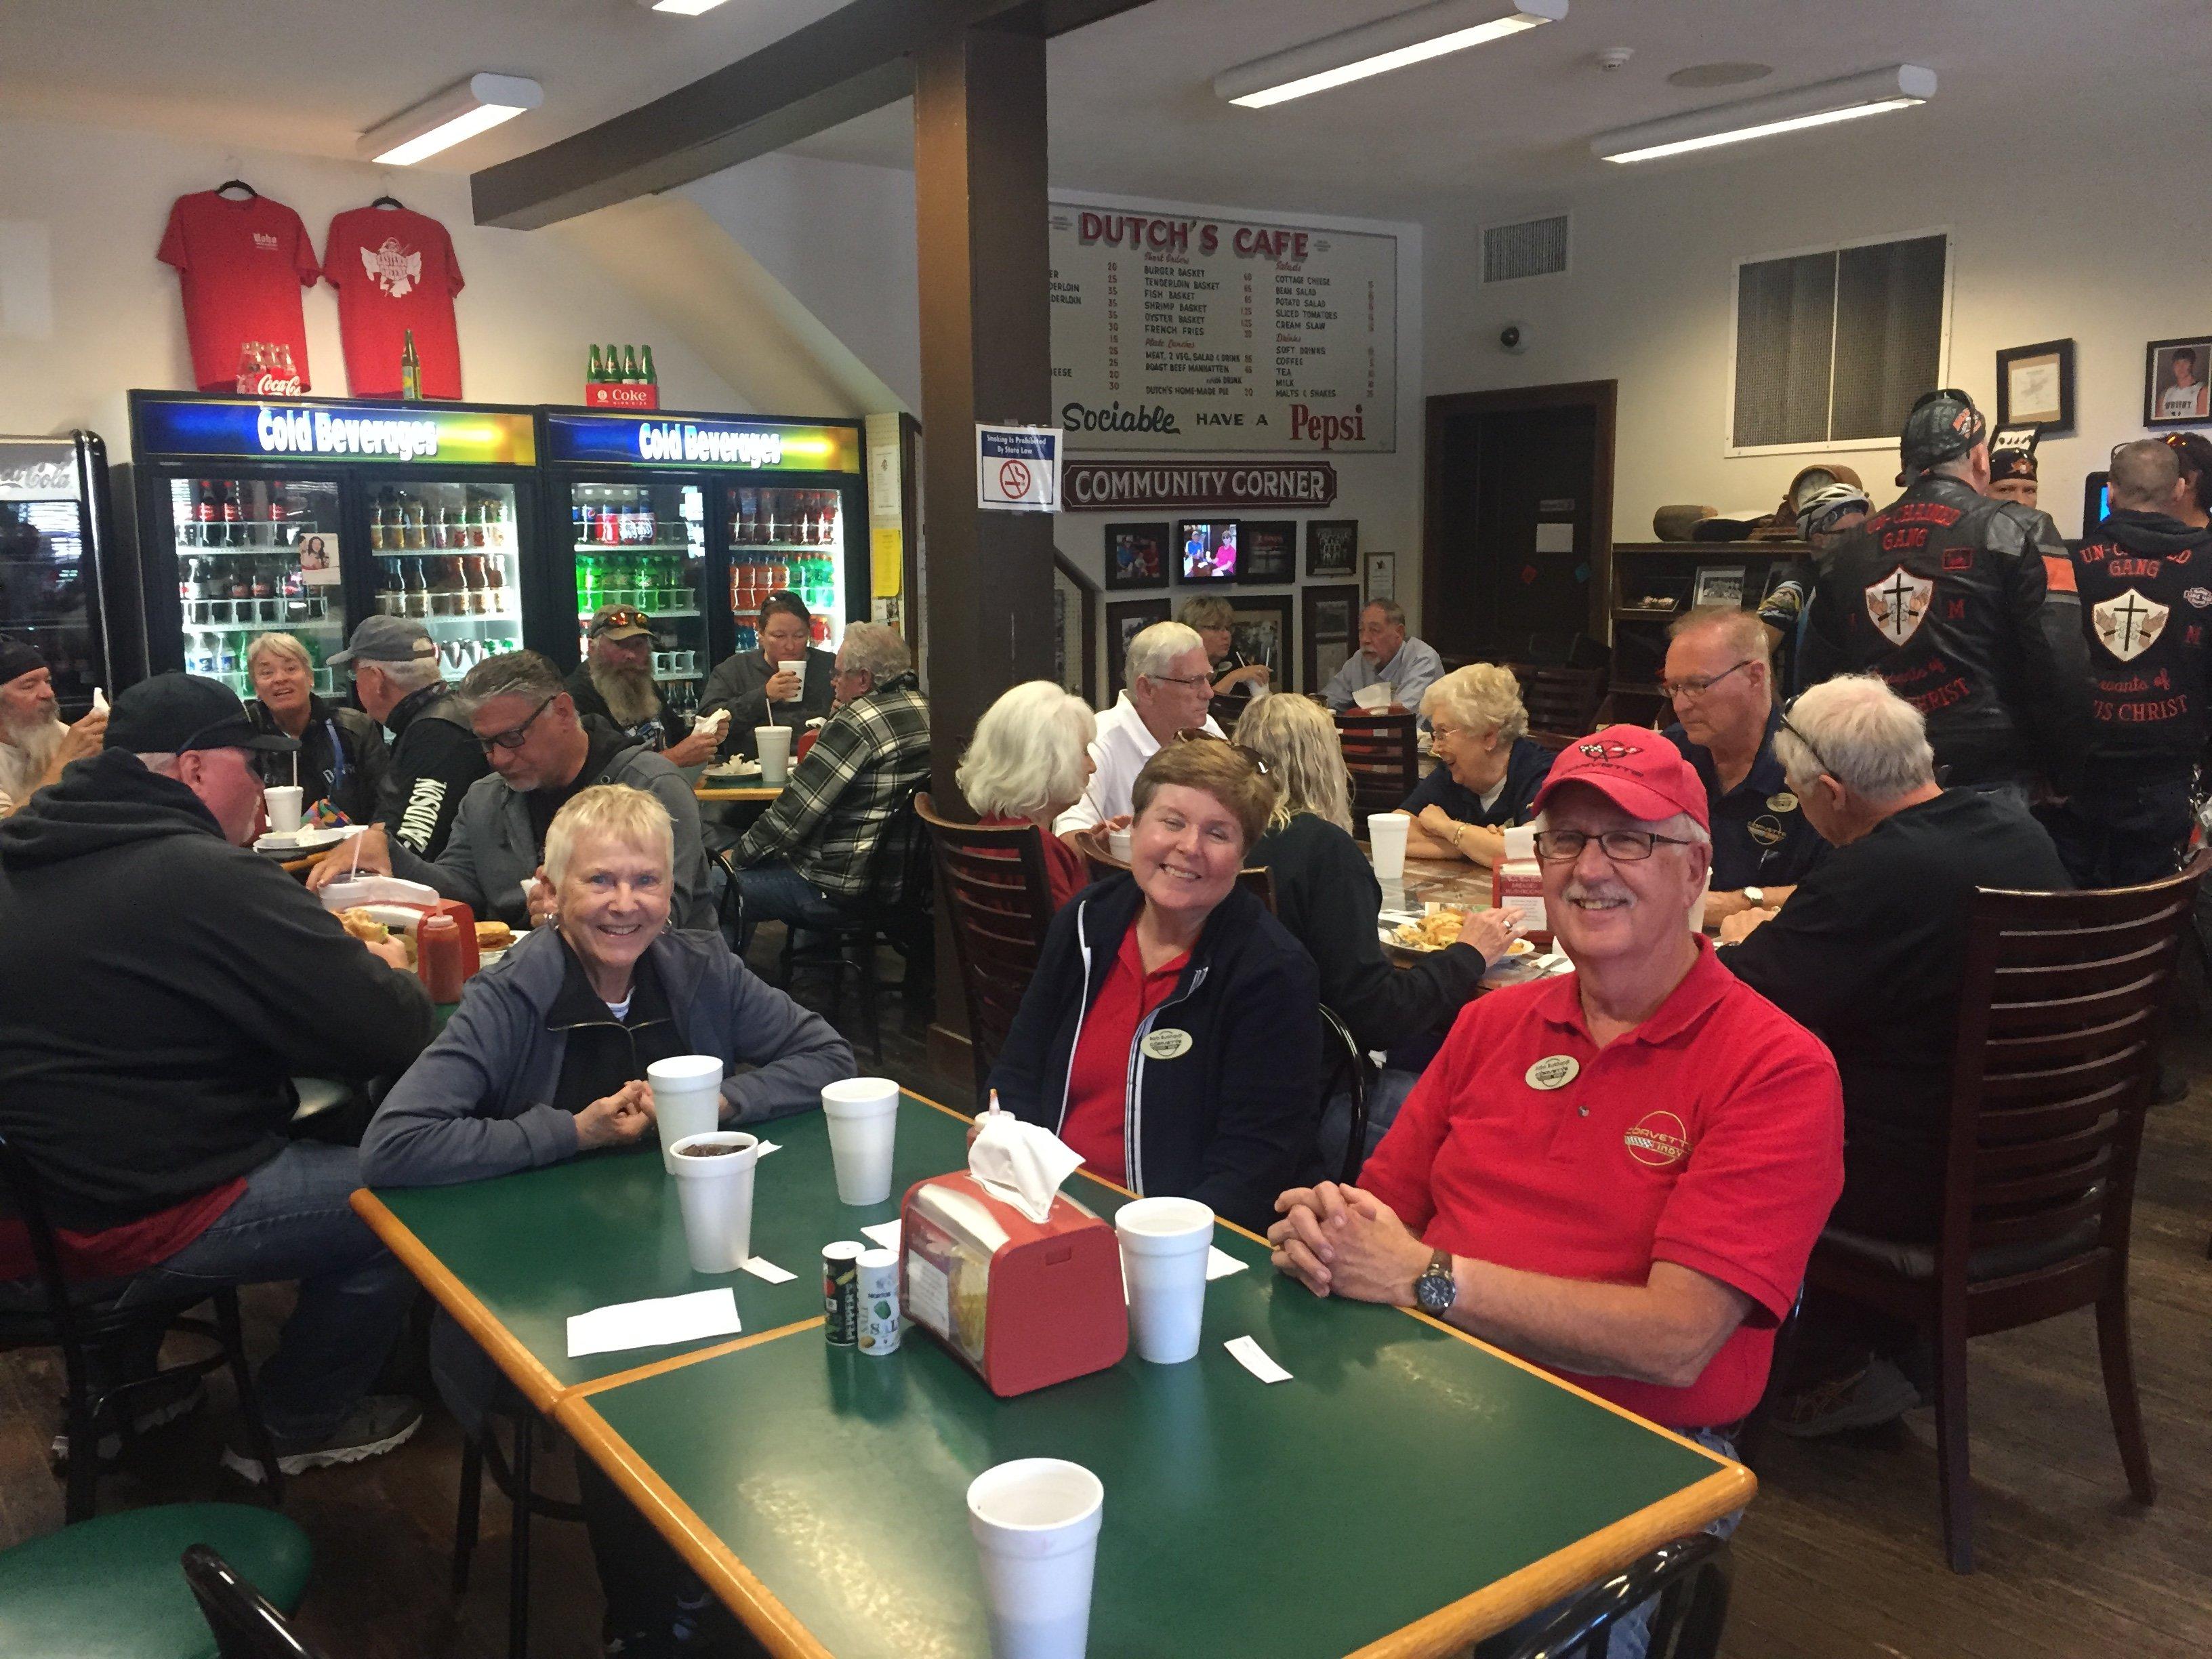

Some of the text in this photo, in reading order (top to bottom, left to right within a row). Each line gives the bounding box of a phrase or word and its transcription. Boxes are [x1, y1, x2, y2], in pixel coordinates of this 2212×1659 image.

[1082, 211, 1309, 258] DUTCH'S CAFE
[1144, 266, 1174, 276] BURGER
[1178, 268, 1205, 278] BASKET
[1144, 277, 1190, 289] TENDERLOIN
[1193, 281, 1220, 290] BASKET
[1275, 274, 1305, 285] COTTAGE
[1307, 276, 1330, 285] CHEESE
[1144, 289, 1163, 299] FISH
[1168, 291, 1195, 300] BASKET
[1275, 286, 1317, 297] BEAN SALAD
[1144, 302, 1174, 310] SHRIMP
[1179, 303, 1207, 313] BASKET
[1275, 298, 1326, 308] POTATO SALAD
[1145, 313, 1173, 323] OYSTER
[1178, 315, 1205, 325] BASKET
[1275, 308, 1338, 320] SLICED TOMATOES
[1145, 325, 1177, 335] FRENCH
[1183, 327, 1204, 336] FRIES
[1275, 320, 1326, 330] CREAM SLAW
[1275, 346, 1326, 355] SOFT DRINKS
[1168, 352, 1173, 361] 2
[1193, 352, 1214, 362] SALAD
[1221, 354, 1240, 363] DRINK
[1275, 356, 1304, 366] COFFEE
[1145, 363, 1168, 371] ROAST
[1170, 363, 1186, 372] BEEF
[1275, 367, 1292, 377] TEA
[1223, 376, 1242, 384] DRINK
[1275, 379, 1294, 387] MILK
[612, 388, 647, 401] Coke
[1145, 386, 1173, 395] DUTCH'S
[1218, 387, 1229, 396] PIE
[1275, 389, 1299, 398] MALTS
[1310, 389, 1336, 398] SHAKES
[1062, 401, 1366, 450] Sociable HAVE A Pepsi
[258, 408, 438, 461] Cold Beverages
[987, 434, 1008, 445] Smoking
[1015, 436, 1046, 445] Prohibited
[639, 423, 782, 468] Cold Beverages
[997, 445, 1004, 454] By
[1004, 446, 1020, 454] State
[1076, 470, 1325, 503] COMMUNITY CORNER
[1883, 528, 1929, 551] GANG
[2108, 558, 2161, 579] GANG
[2118, 694, 2188, 722] CHRIST
